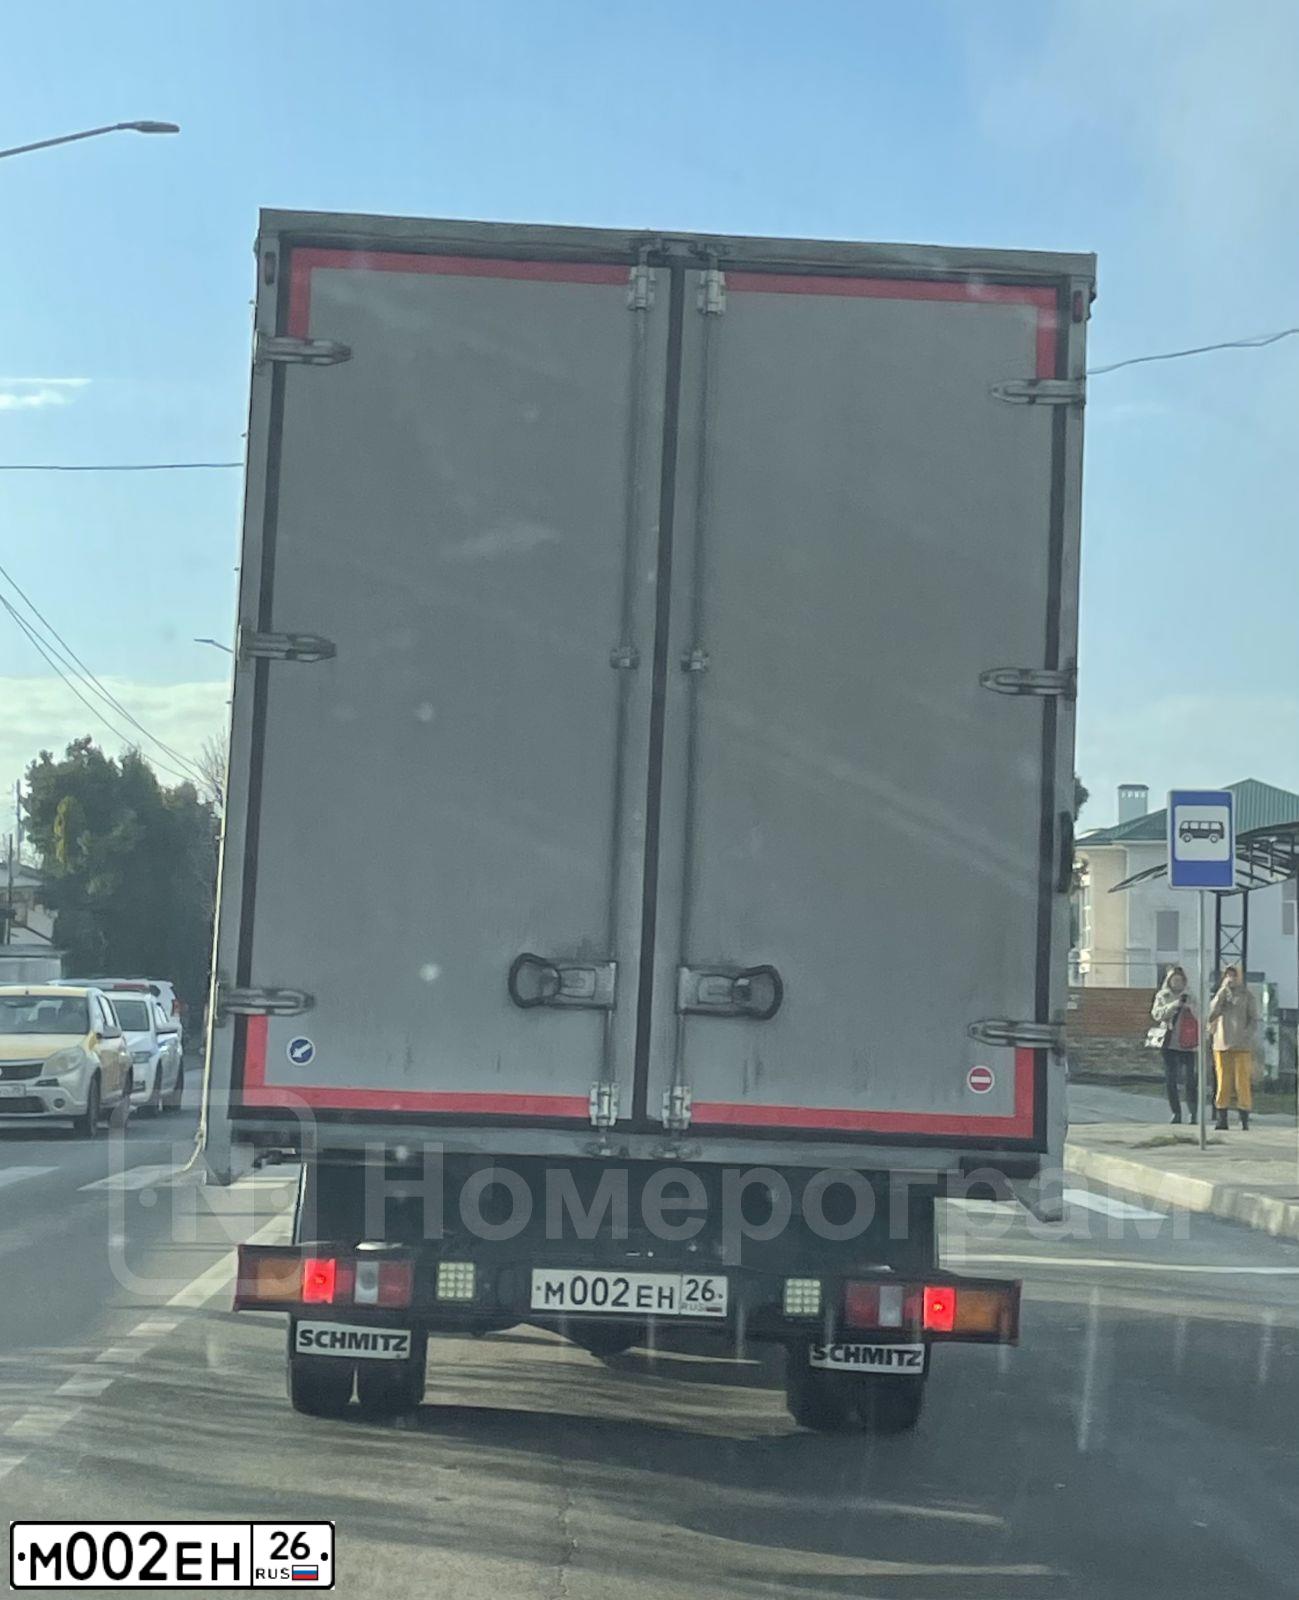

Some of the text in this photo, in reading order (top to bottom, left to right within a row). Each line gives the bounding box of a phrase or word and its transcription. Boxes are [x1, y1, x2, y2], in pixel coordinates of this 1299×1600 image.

[686, 1279, 715, 1301] 26
[299, 1329, 408, 1352] SCHMITZ
[812, 1342, 922, 1366] SCHMITZ
